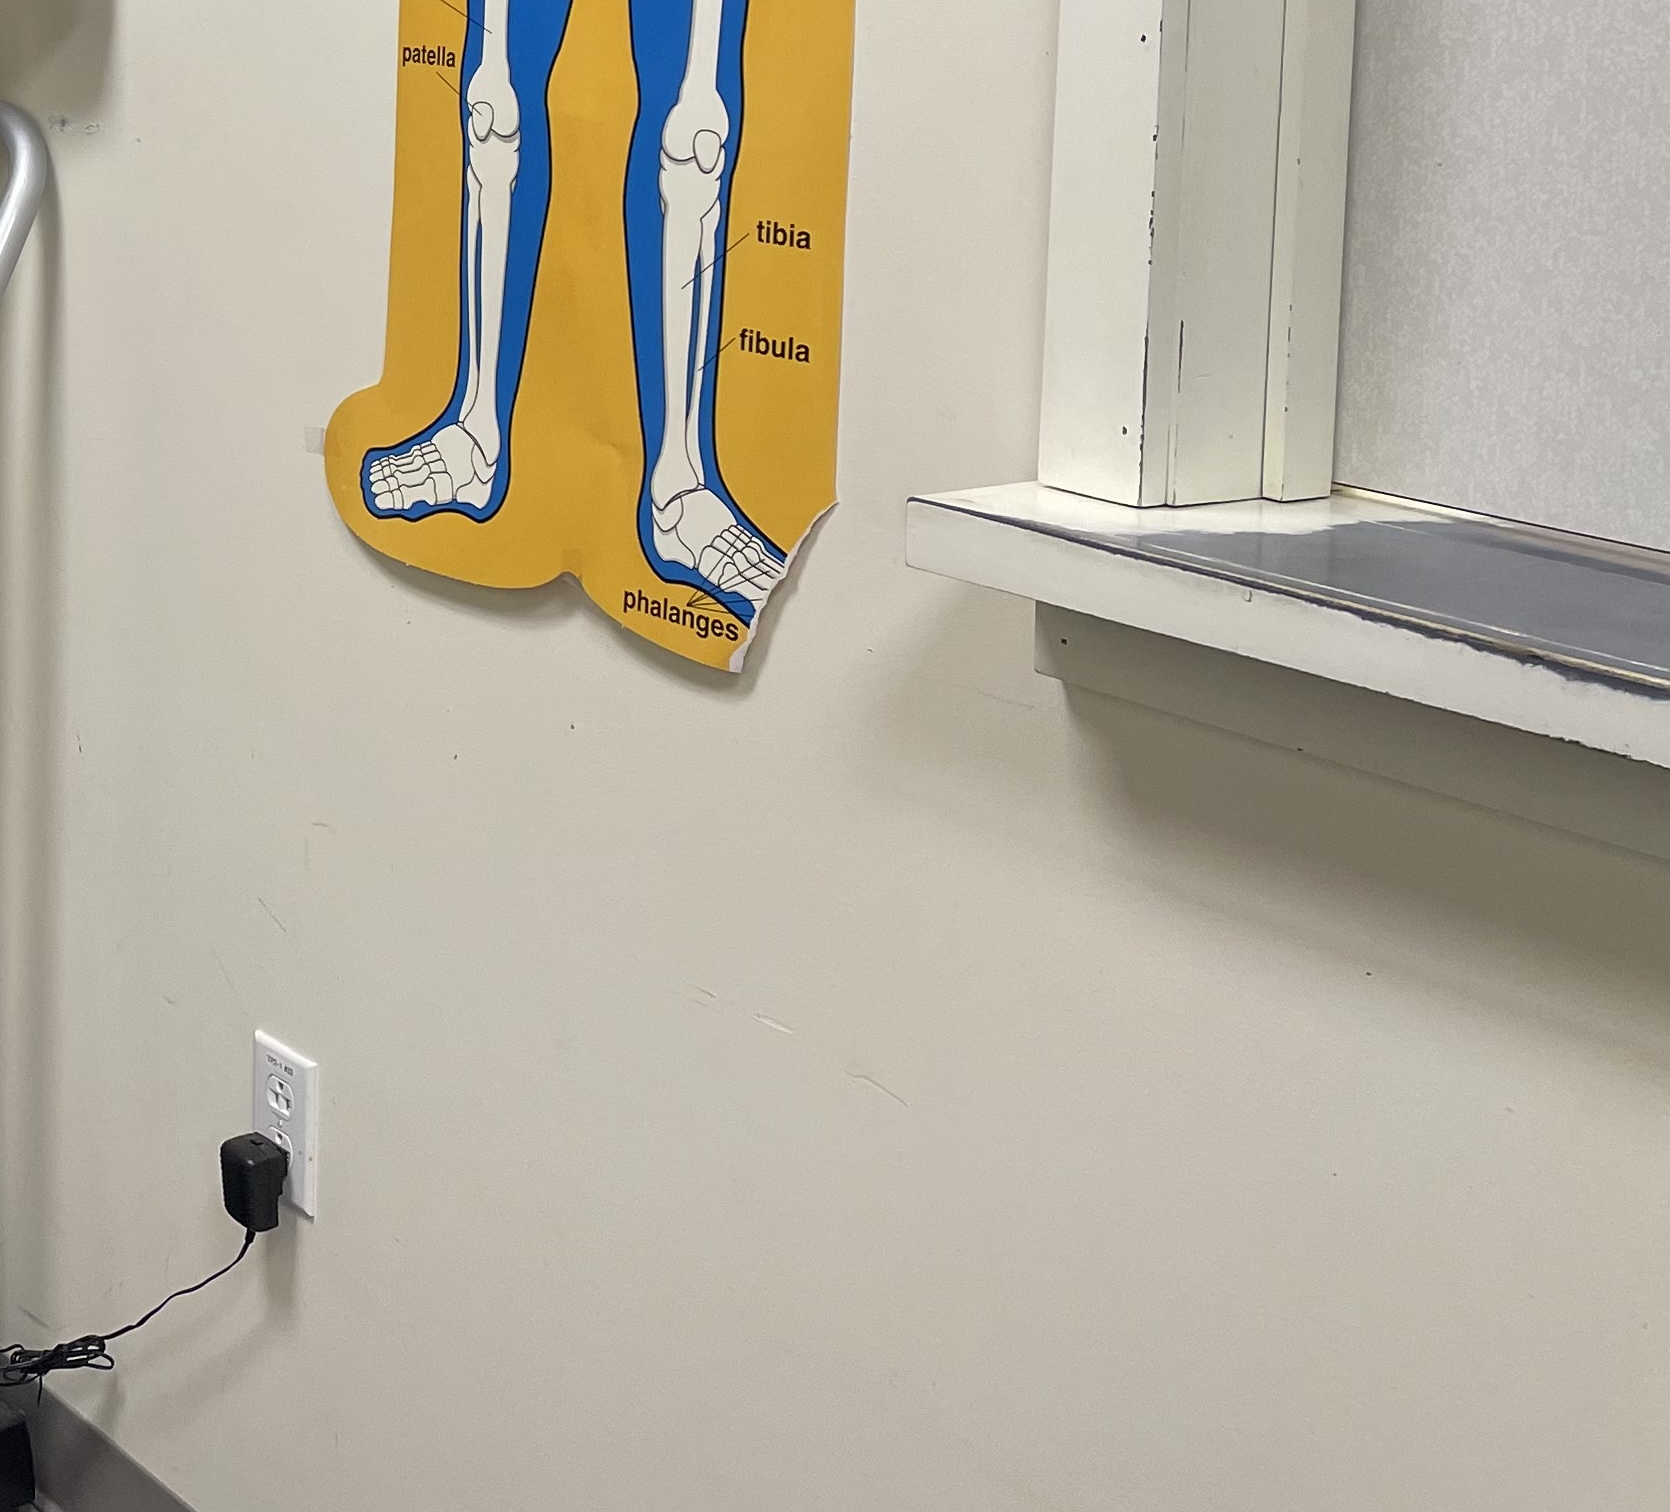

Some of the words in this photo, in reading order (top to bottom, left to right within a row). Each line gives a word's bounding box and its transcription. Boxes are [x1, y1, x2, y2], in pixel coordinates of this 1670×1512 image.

[403, 45, 455, 67] patella
[757, 221, 810, 249] tibia
[740, 329, 809, 363] fibula
[622, 588, 740, 643] phalanges
